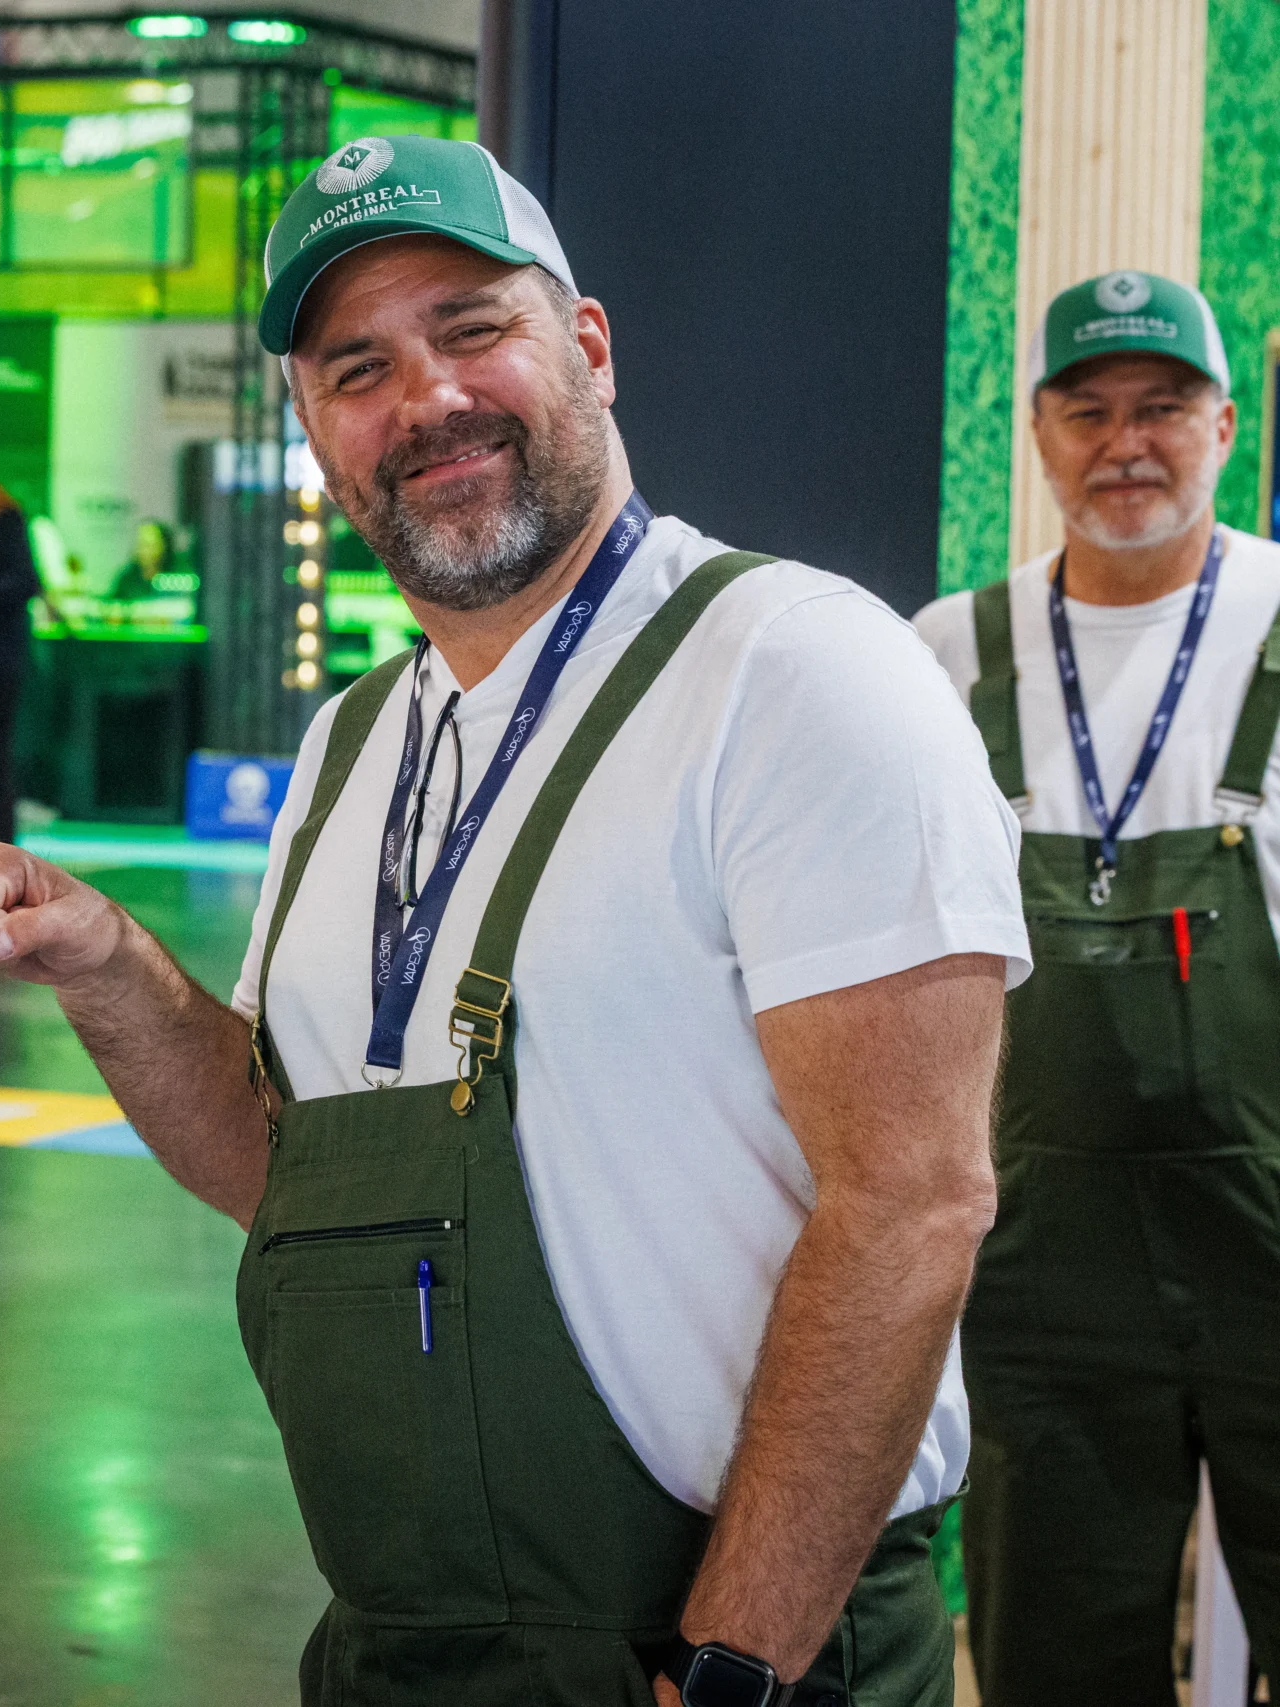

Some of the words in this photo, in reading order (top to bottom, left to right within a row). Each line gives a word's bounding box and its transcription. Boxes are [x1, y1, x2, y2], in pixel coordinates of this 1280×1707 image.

[343, 150, 362, 168] M
[308, 184, 424, 236] MONTREAL
[611, 515, 644, 554] VAPEXPO
[553, 601, 592, 652] VAPEXPO
[501, 707, 536, 762] VAPEXPO
[445, 815, 480, 870] VAPEXPO
[401, 926, 431, 985] VAPEXPO
